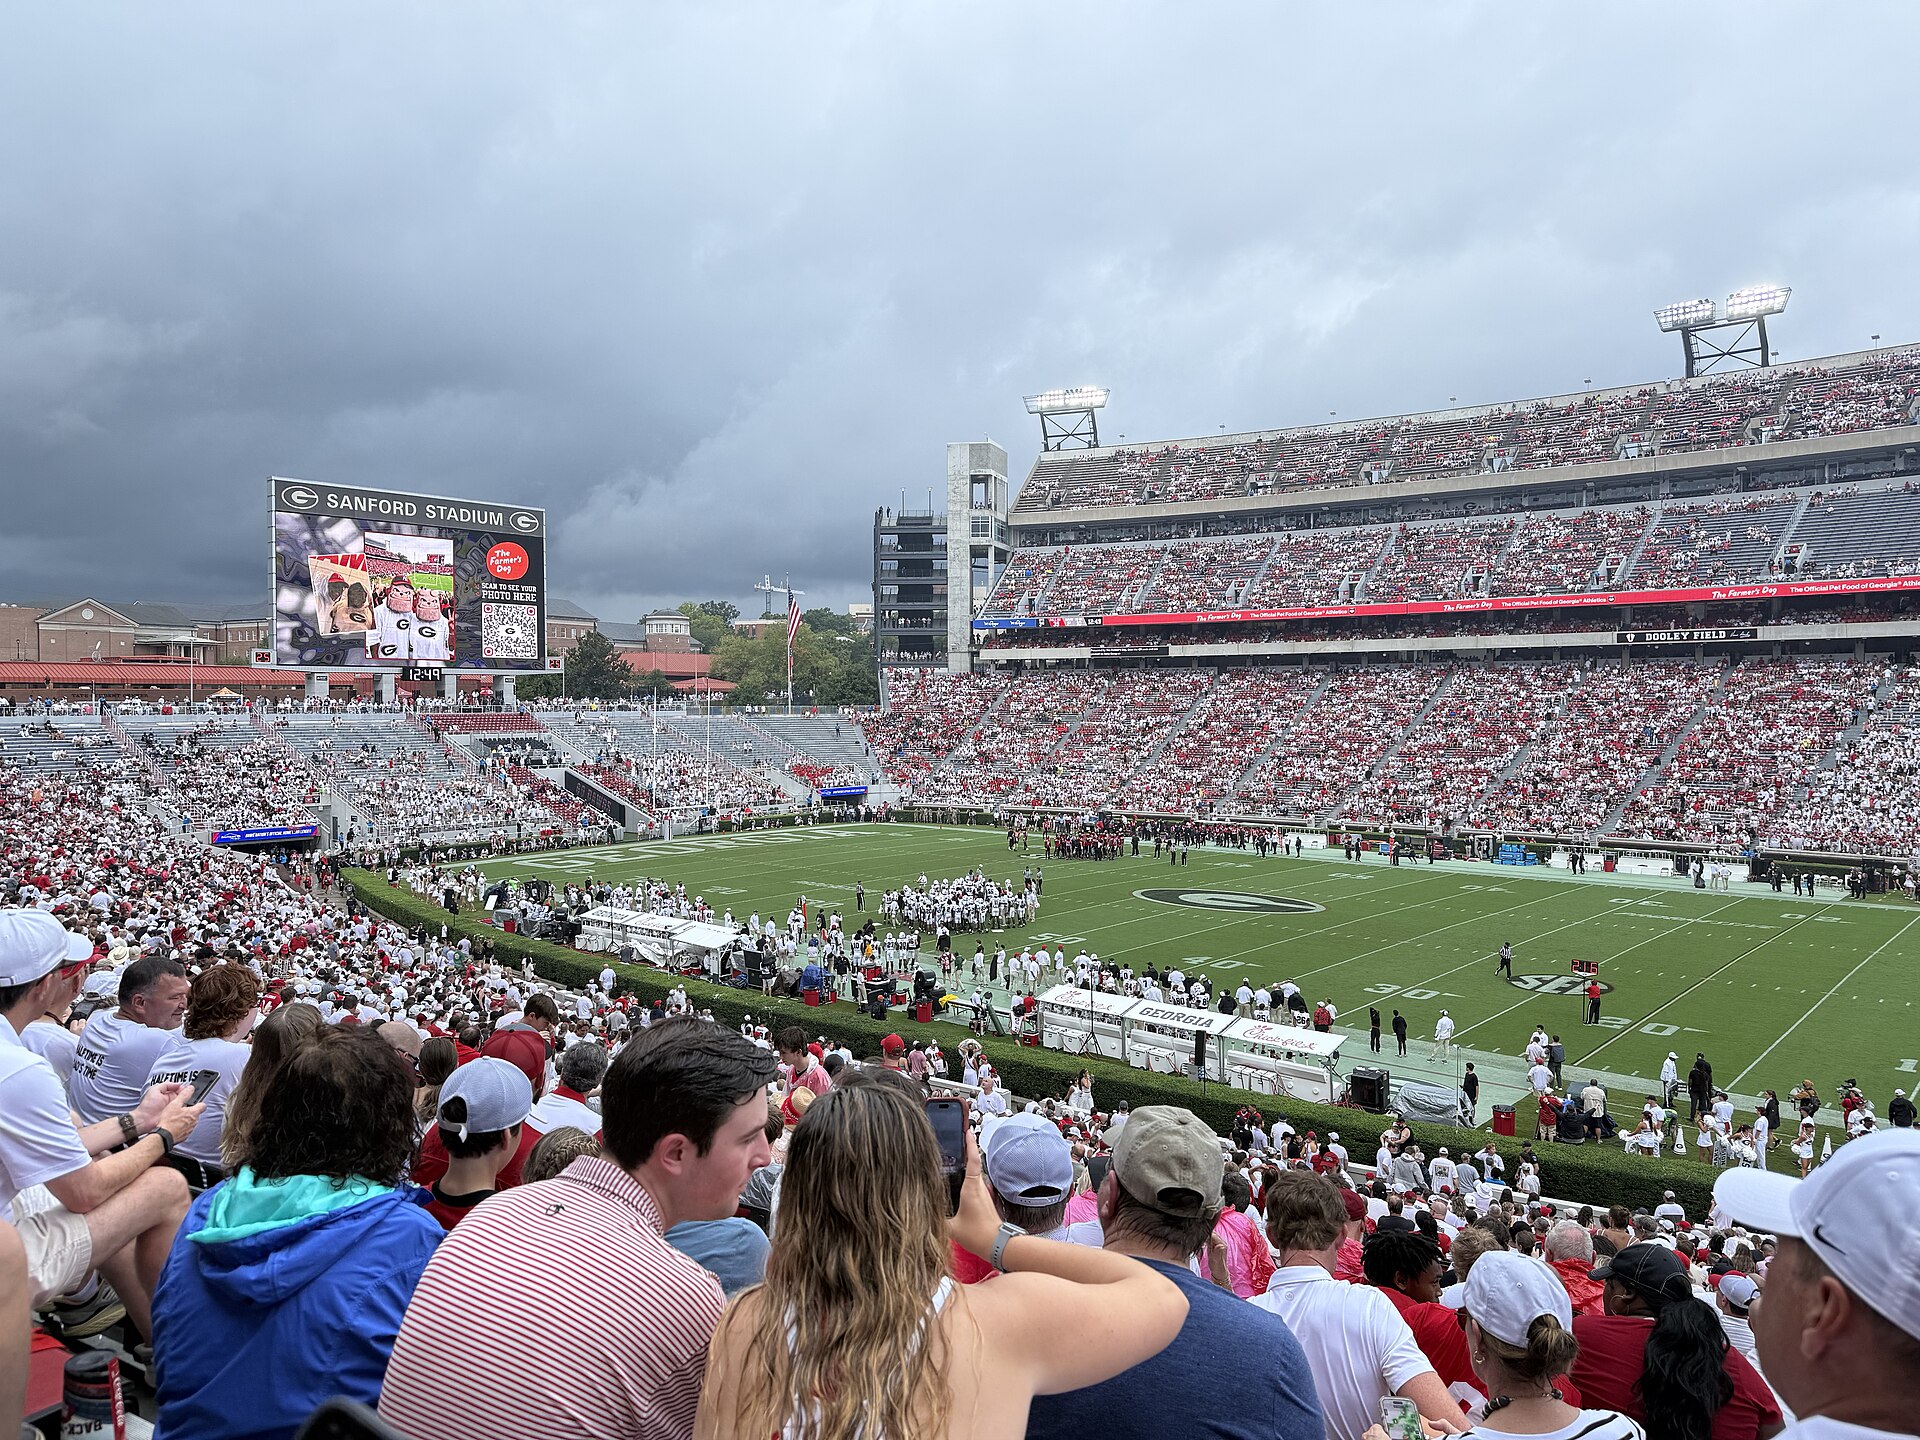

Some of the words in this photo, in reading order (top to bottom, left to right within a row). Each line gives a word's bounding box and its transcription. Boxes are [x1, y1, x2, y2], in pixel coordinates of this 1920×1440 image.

[327, 493, 417, 518] SANFORD
[425, 505, 503, 526] STADIUM
[494, 549, 511, 557] The
[490, 556, 522, 566] Farmer's
[496, 565, 512, 574] Dog
[482, 582, 498, 590] SCAN
[482, 590, 511, 600] PHOTO
[513, 592, 537, 602] HERE
[1711, 591, 1726, 599] The
[1728, 588, 1760, 597] Farmer's
[1762, 586, 1777, 595] Dog
[1645, 632, 1690, 641] DOOLEY
[1693, 631, 1726, 640] FIELD
[409, 669, 440, 681] 12:49
[1363, 983, 1441, 1000] 30
[1139, 1007, 1214, 1028] GEORGIA
[95, 1054, 105, 1067] IS
[82, 1065, 98, 1080] TIME
[150, 1072, 189, 1086] HALFTIME
[188, 1071, 199, 1082] IS
